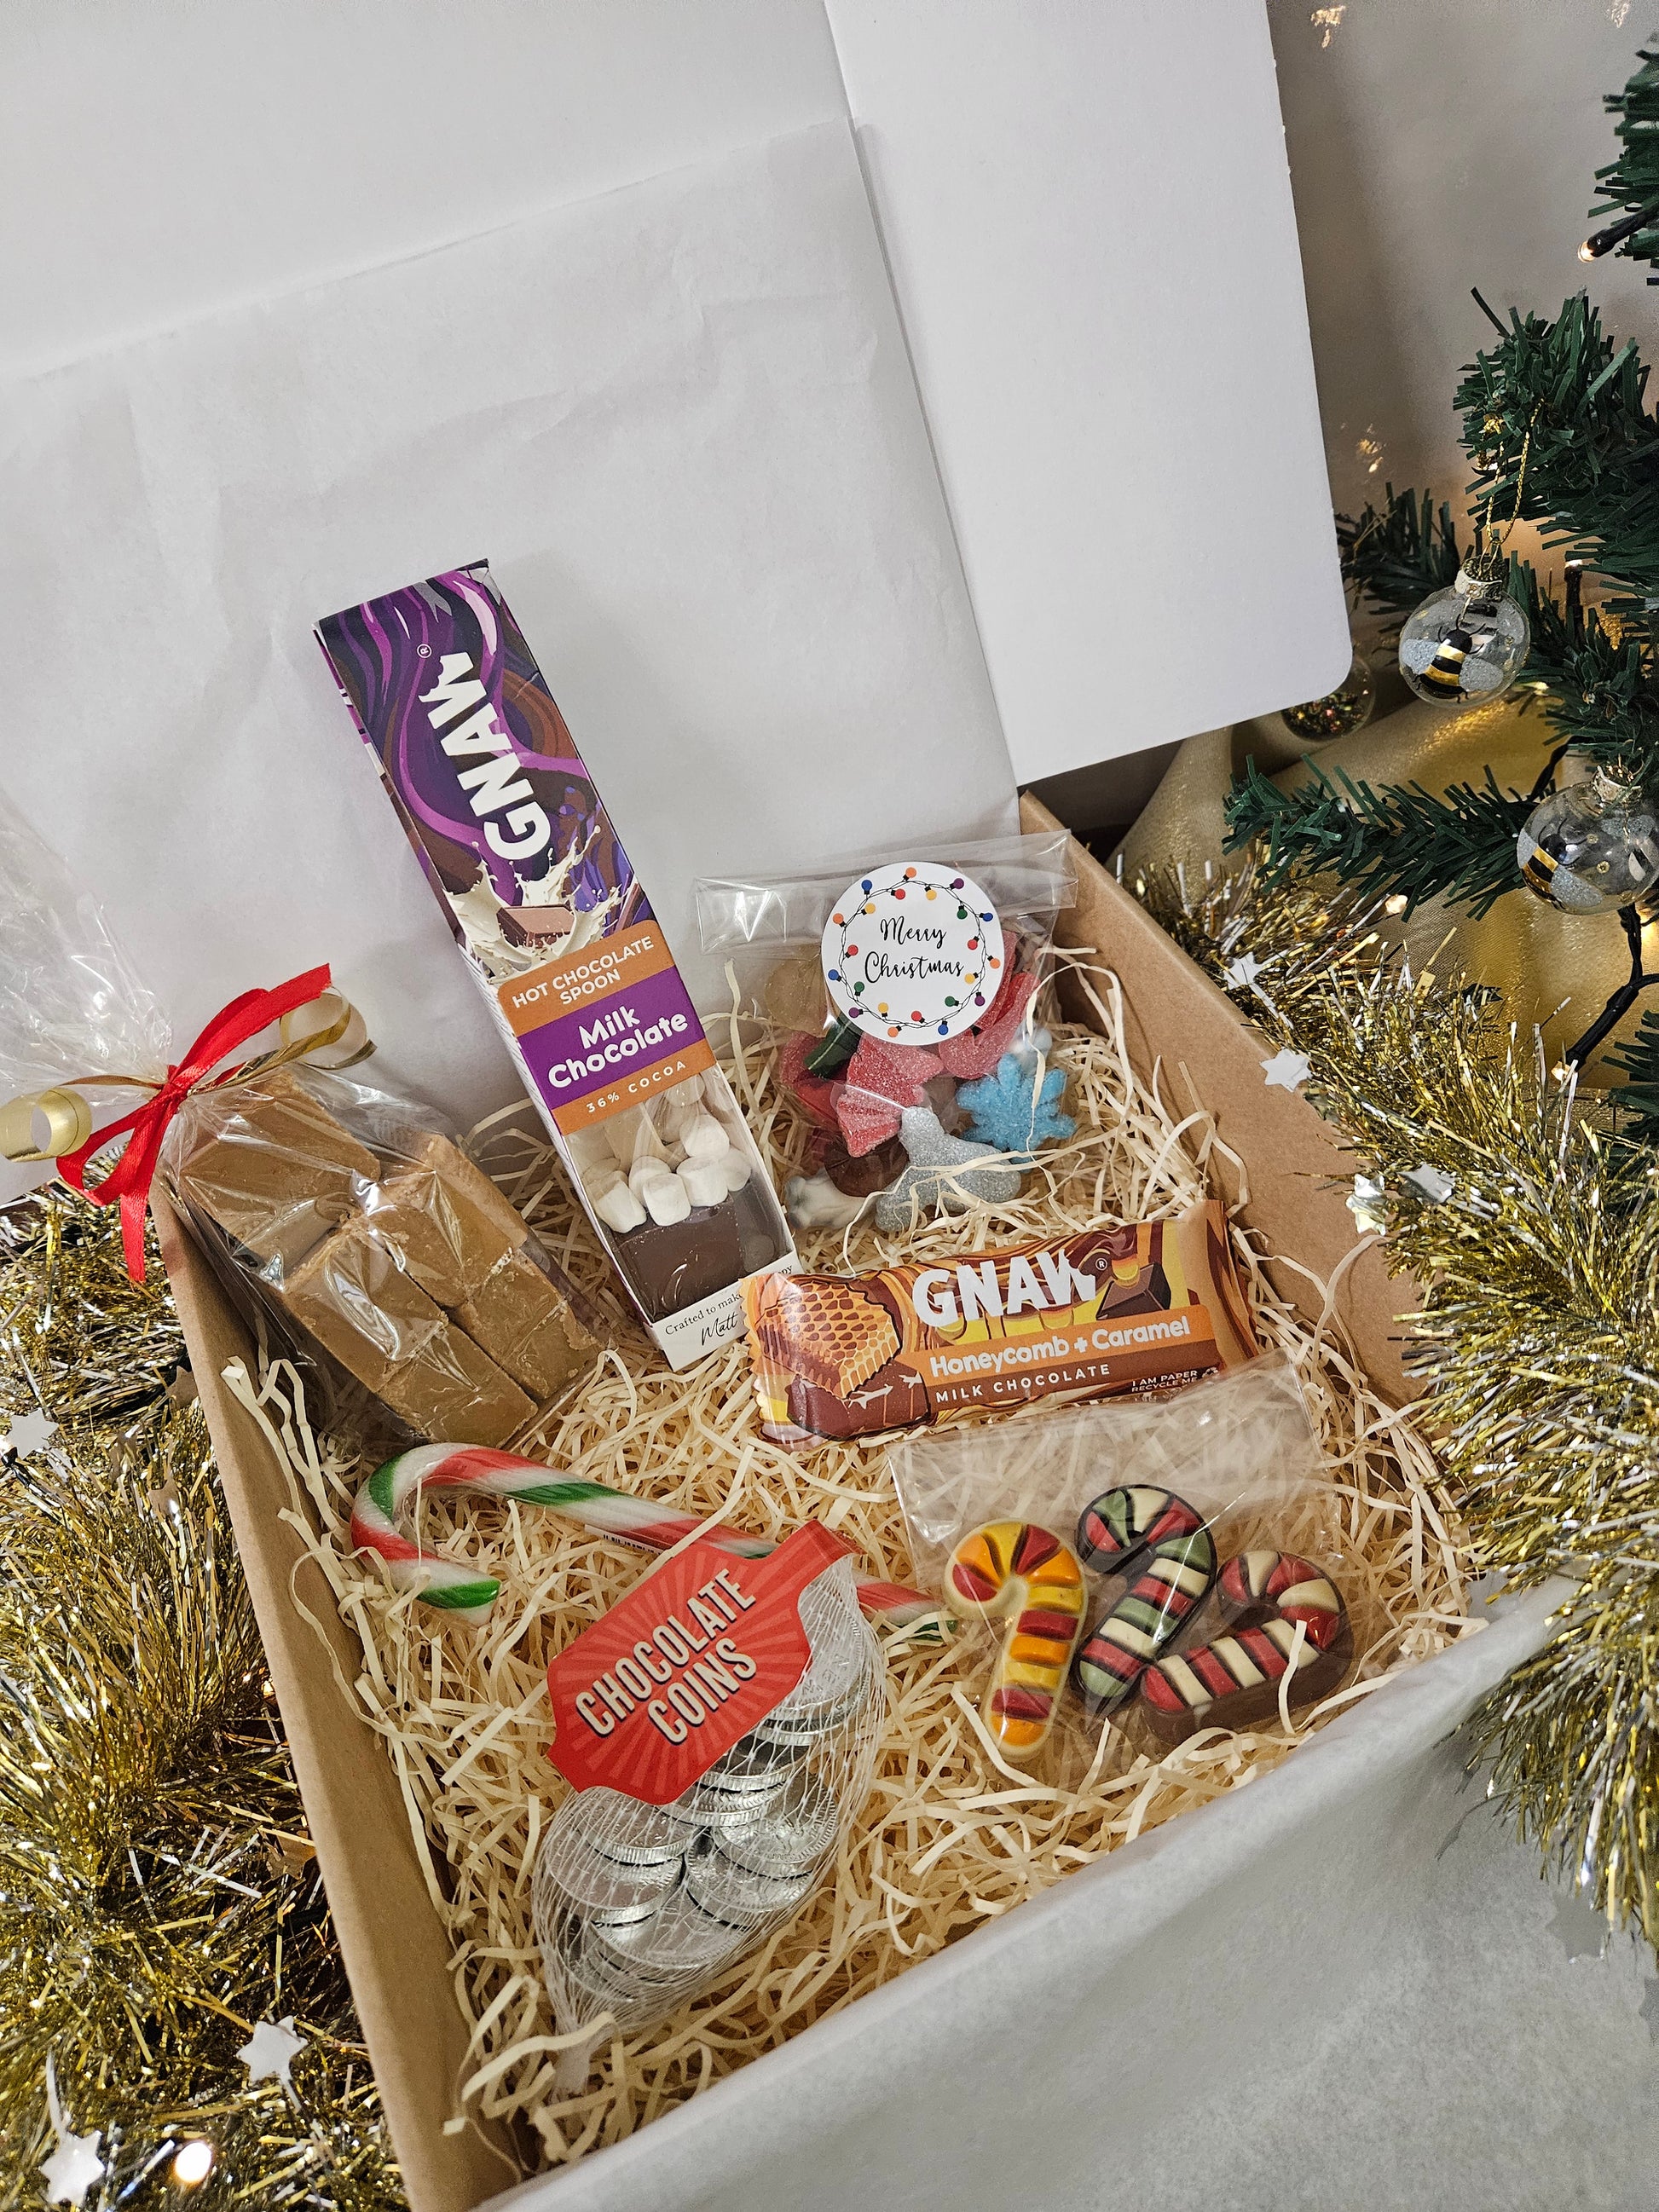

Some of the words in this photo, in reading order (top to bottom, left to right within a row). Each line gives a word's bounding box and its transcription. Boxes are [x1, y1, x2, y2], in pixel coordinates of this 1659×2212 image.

[419, 652, 551, 860] GNAW
[879, 915, 947, 949] Merry
[512, 982, 549, 1008] HOT
[552, 935, 654, 990] CHOCOLATE
[560, 969, 621, 1005] SPOON
[864, 951, 965, 983] Christmas
[578, 1006, 640, 1049] Milk
[547, 1013, 688, 1088] Chocolate
[587, 1092, 620, 1113] 36%
[627, 1060, 685, 1093] COCOA
[912, 1249, 1096, 1328] GNAW
[665, 1310, 705, 1336] Crafted
[707, 1304, 717, 1315] to
[701, 1311, 739, 1346] Matt
[929, 1338, 1070, 1378] Honeycomb
[1090, 1315, 1190, 1351] Caramel
[936, 1385, 983, 1403] MILK
[992, 1364, 1111, 1393] CHOCOLATE
[1131, 1380, 1179, 1393] RECYCLE
[1140, 1377, 1157, 1385] AM
[1160, 1370, 1198, 1382] PAPER
[575, 1568, 757, 1738] CHOCOLATE
[647, 1637, 757, 1745] COINS
